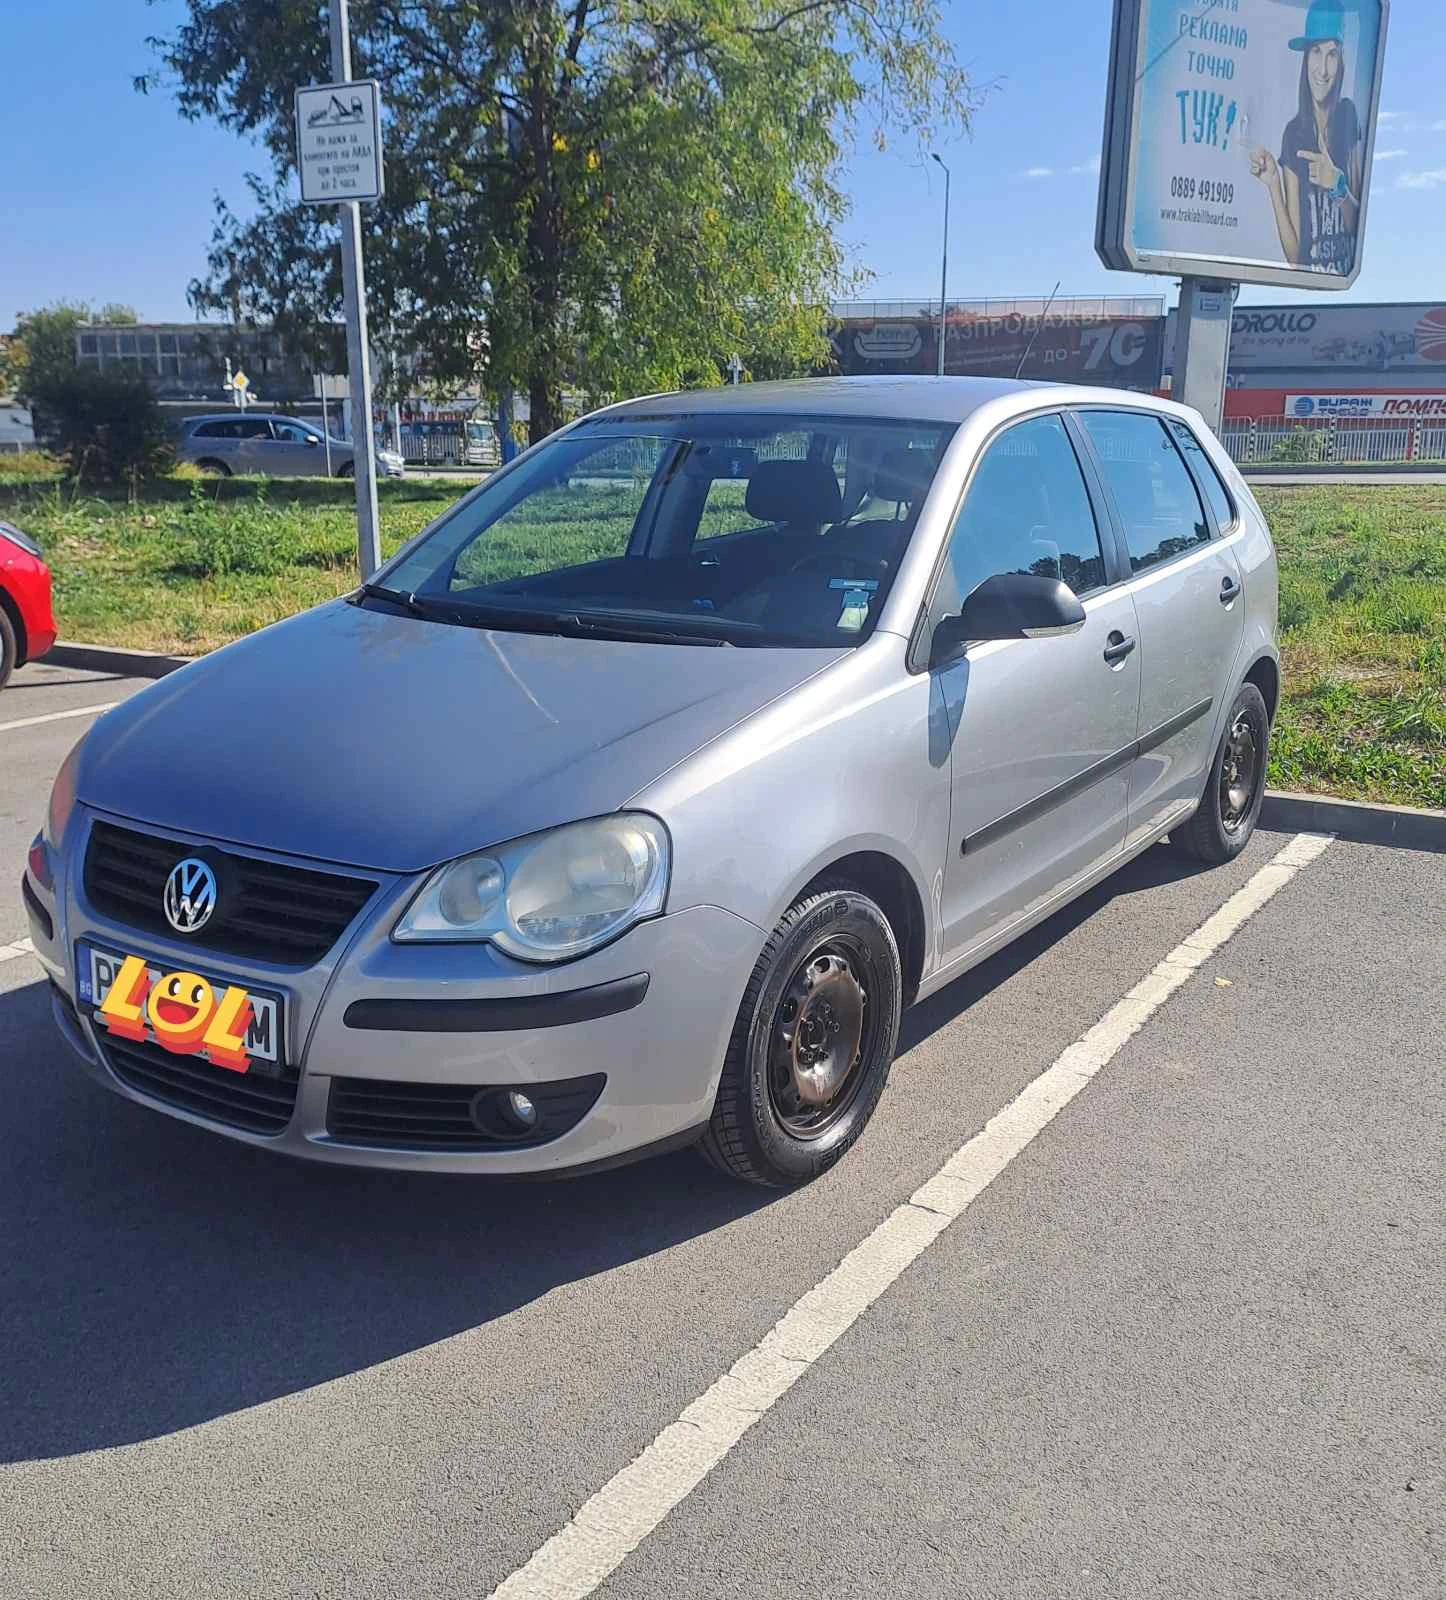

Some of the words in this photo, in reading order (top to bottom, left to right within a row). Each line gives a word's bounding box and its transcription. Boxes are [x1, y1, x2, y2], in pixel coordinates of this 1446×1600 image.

[1179, 13, 1248, 49] РЕКЛАМА
[1188, 50, 1235, 80] ТОЧНО
[1175, 89, 1237, 151] ТУК!
[1171, 176, 1195, 199] 0889
[1198, 180, 1234, 204] 491909
[1160, 208, 1238, 227] www.trakiabillboard.com
[80, 980, 92, 996] BG
